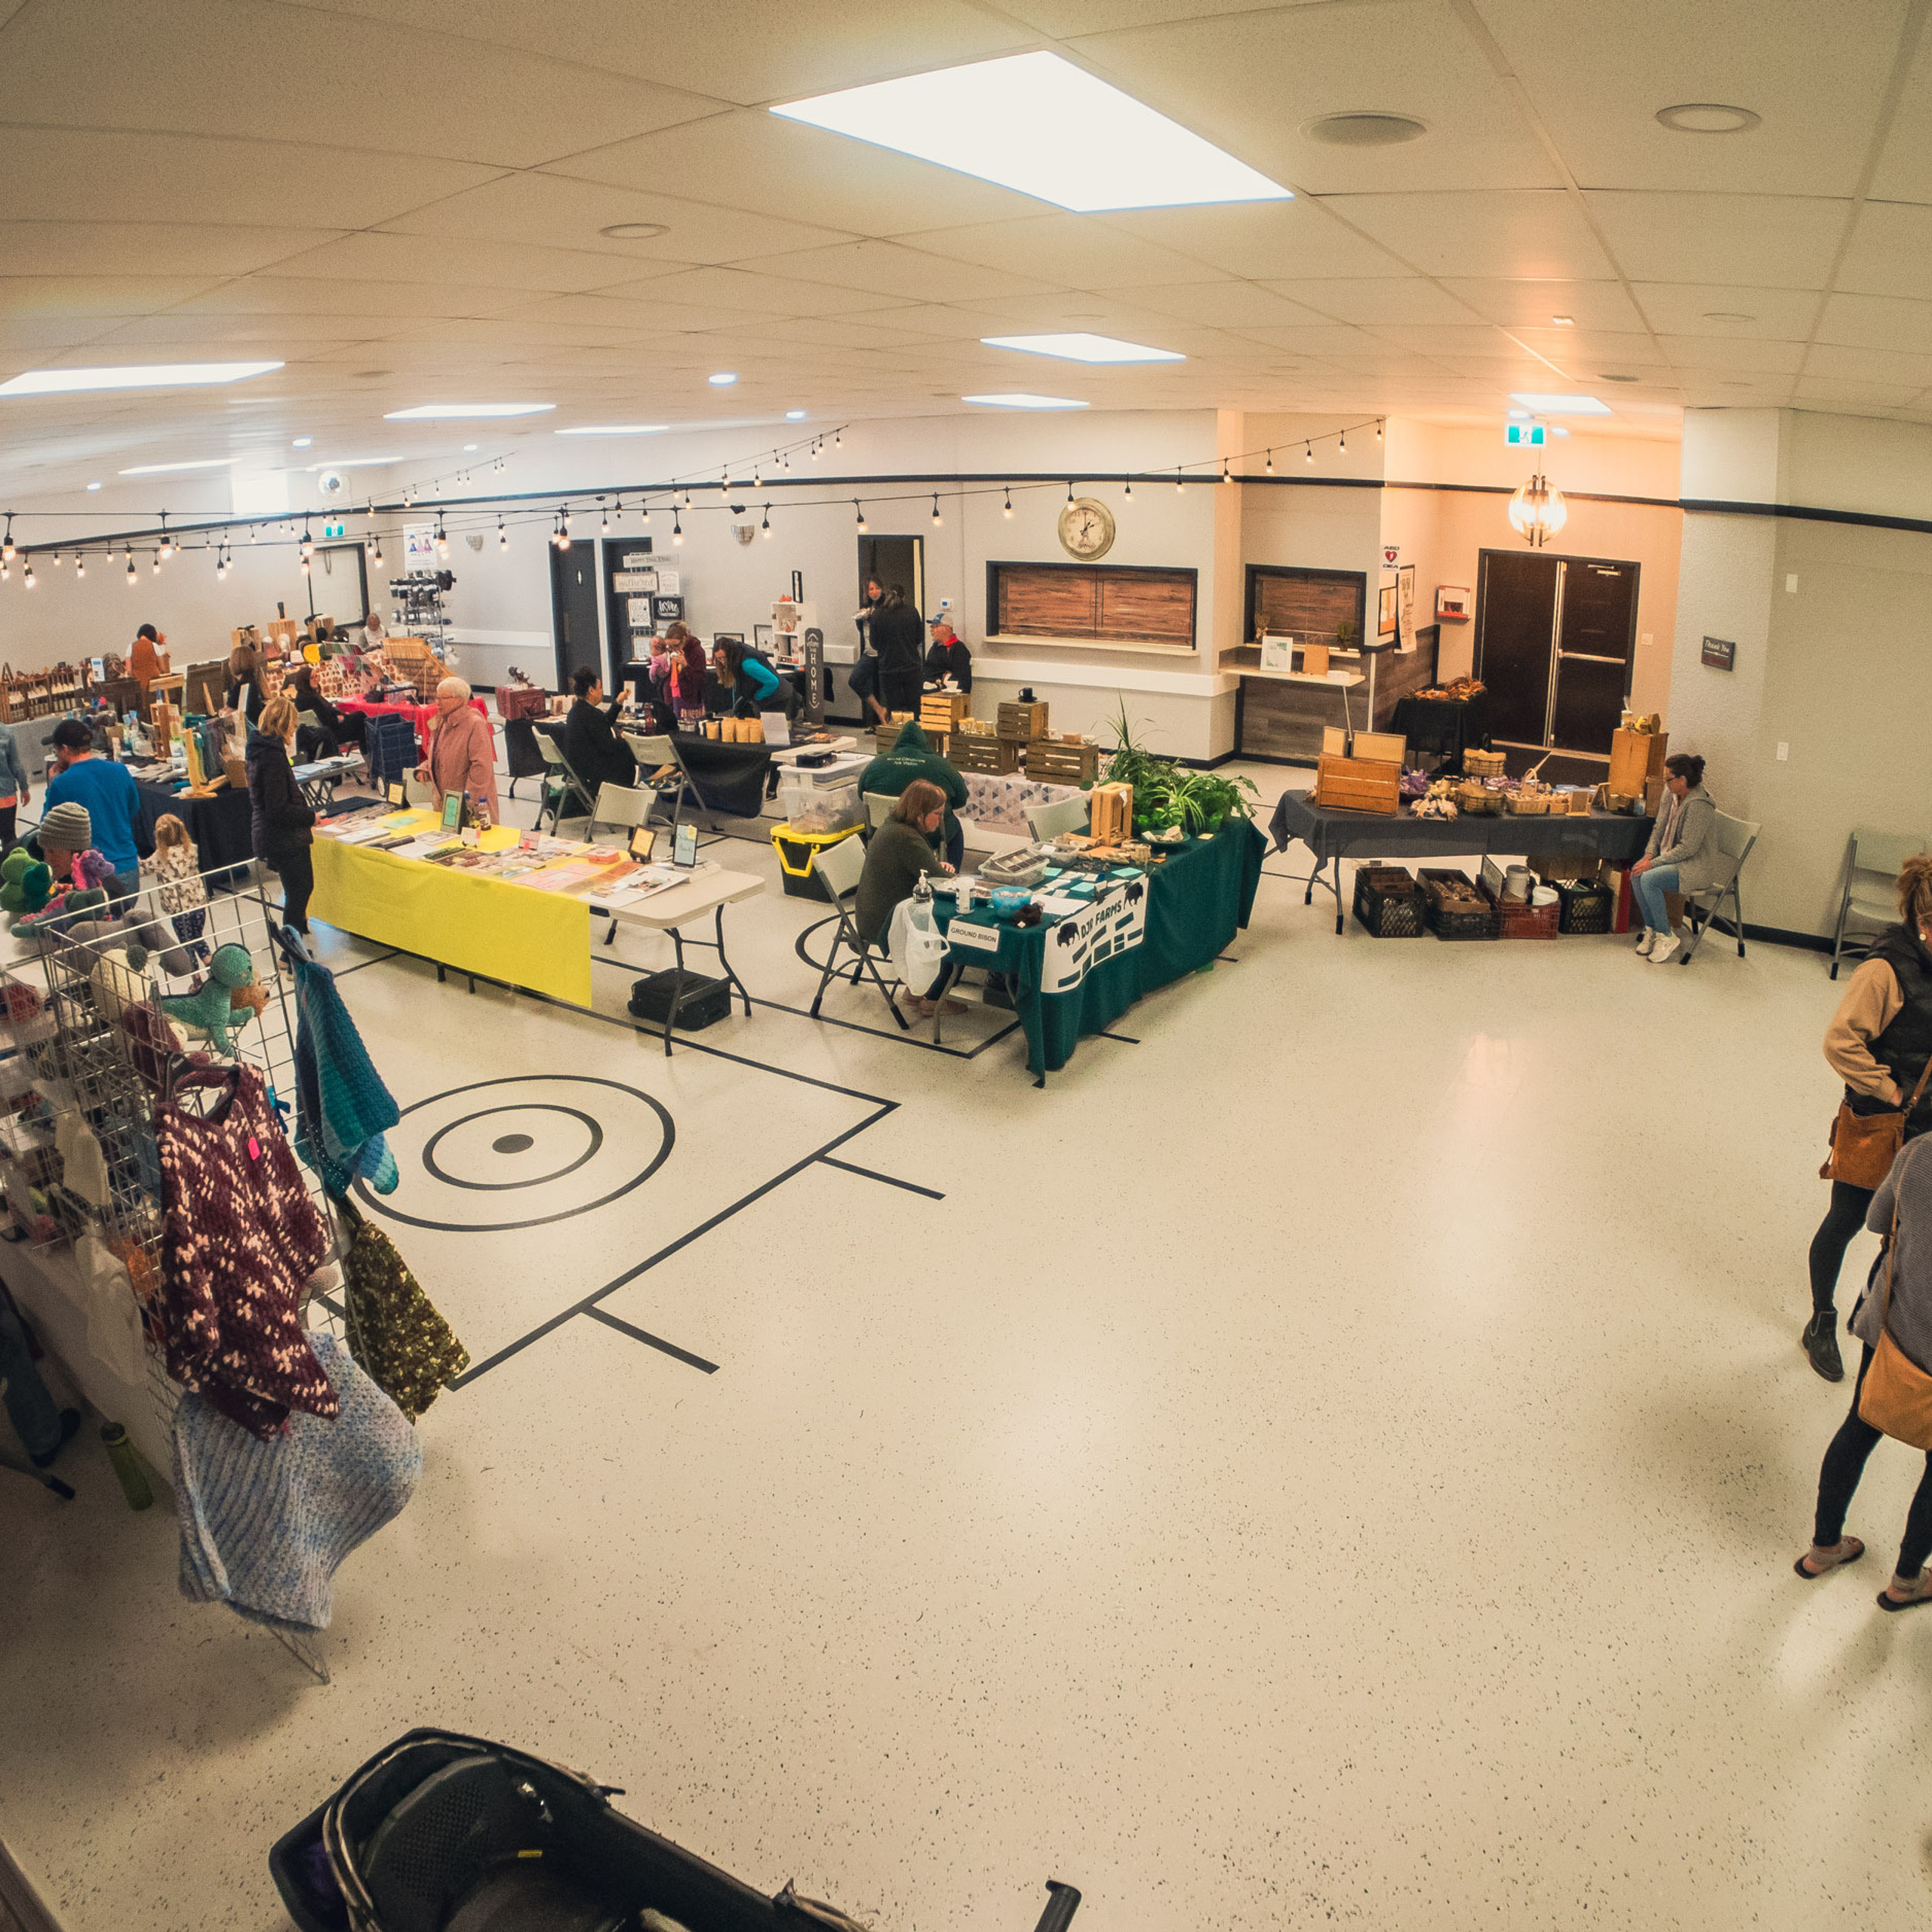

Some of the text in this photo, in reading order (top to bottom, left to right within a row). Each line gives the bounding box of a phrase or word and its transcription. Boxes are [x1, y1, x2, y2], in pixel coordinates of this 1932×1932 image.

[1705, 639, 1720, 651] Thank
[1095, 900, 1121, 926] FARMS
[950, 927, 997, 943] GROUND BISON
